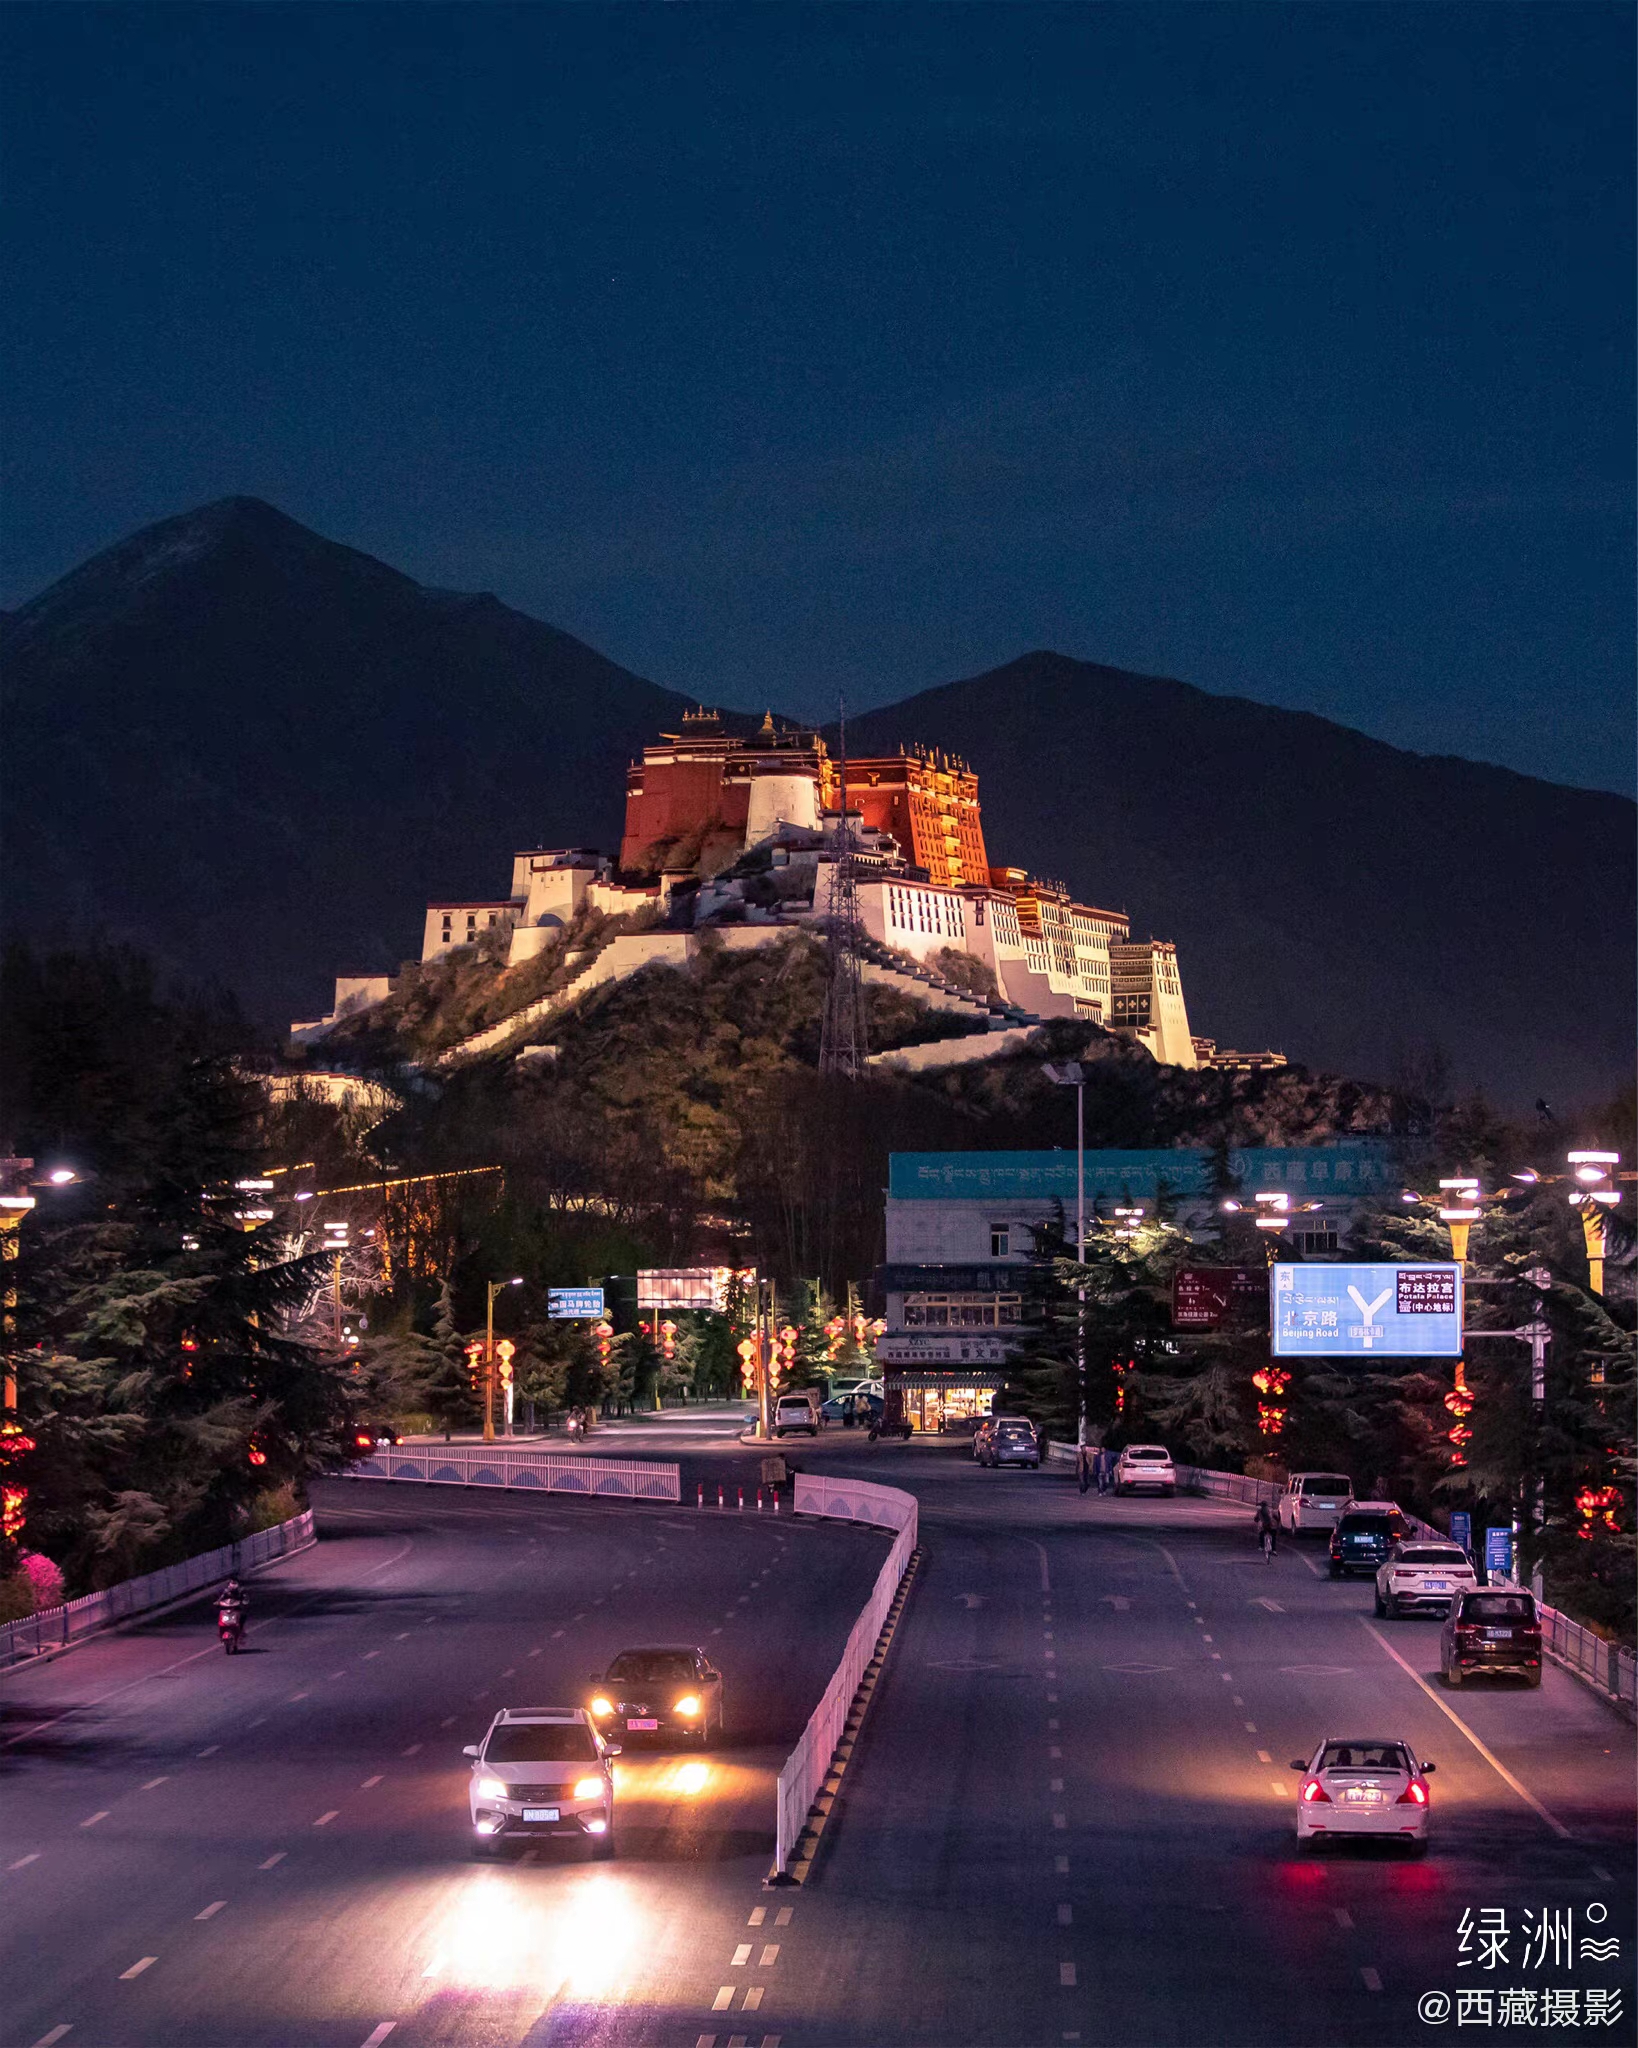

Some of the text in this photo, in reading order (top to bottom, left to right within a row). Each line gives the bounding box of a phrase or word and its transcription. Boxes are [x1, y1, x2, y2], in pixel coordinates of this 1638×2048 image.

[1399, 1282, 1454, 1293] 布达拉宫
[1283, 1311, 1338, 1326] 北京路
[1282, 1327, 1339, 1339] Beijing Road
